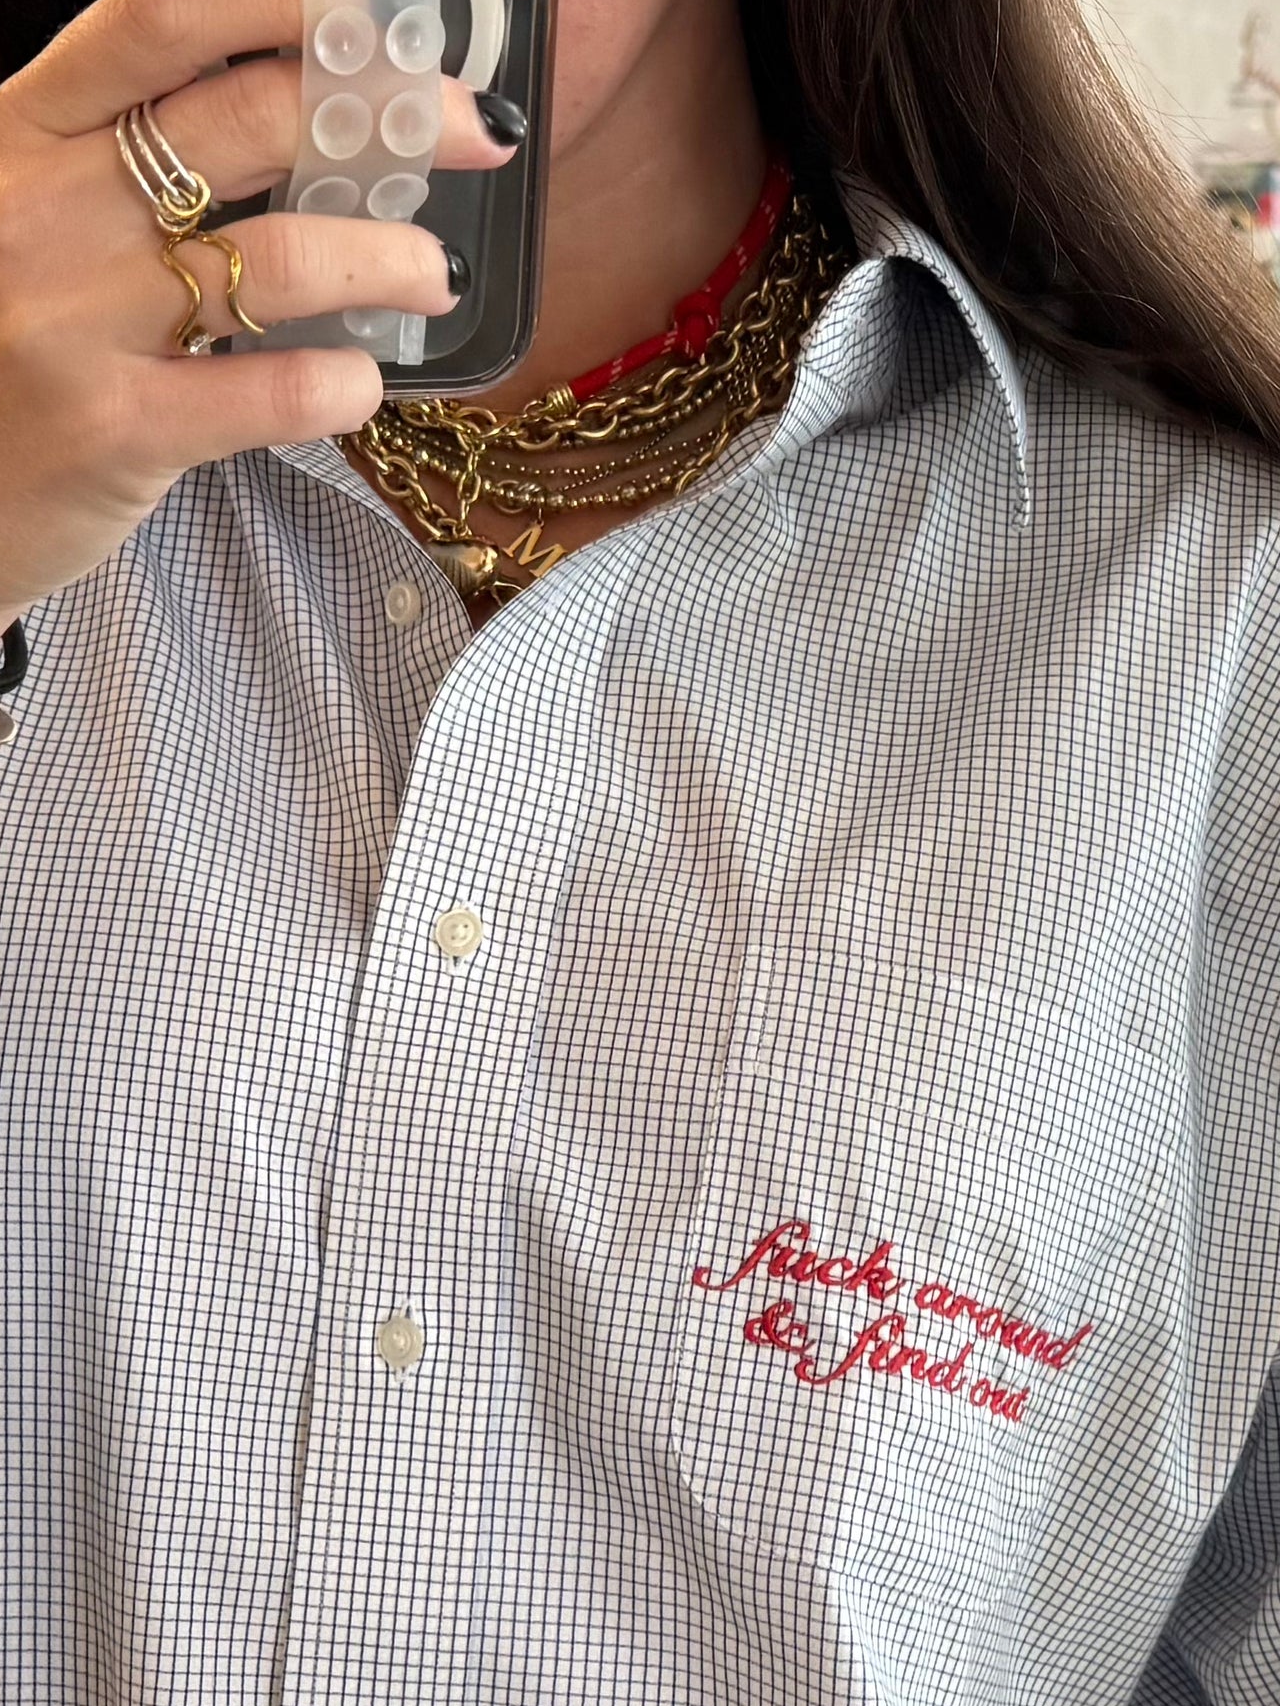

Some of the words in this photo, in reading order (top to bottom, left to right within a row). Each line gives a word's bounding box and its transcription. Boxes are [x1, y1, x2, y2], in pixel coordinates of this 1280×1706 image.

[502, 524, 567, 577] M
[690, 1220, 907, 1300] fuck
[914, 1283, 1096, 1371] around
[743, 1297, 817, 1354] &
[793, 1313, 974, 1393] find
[969, 1378, 1032, 1424] out
